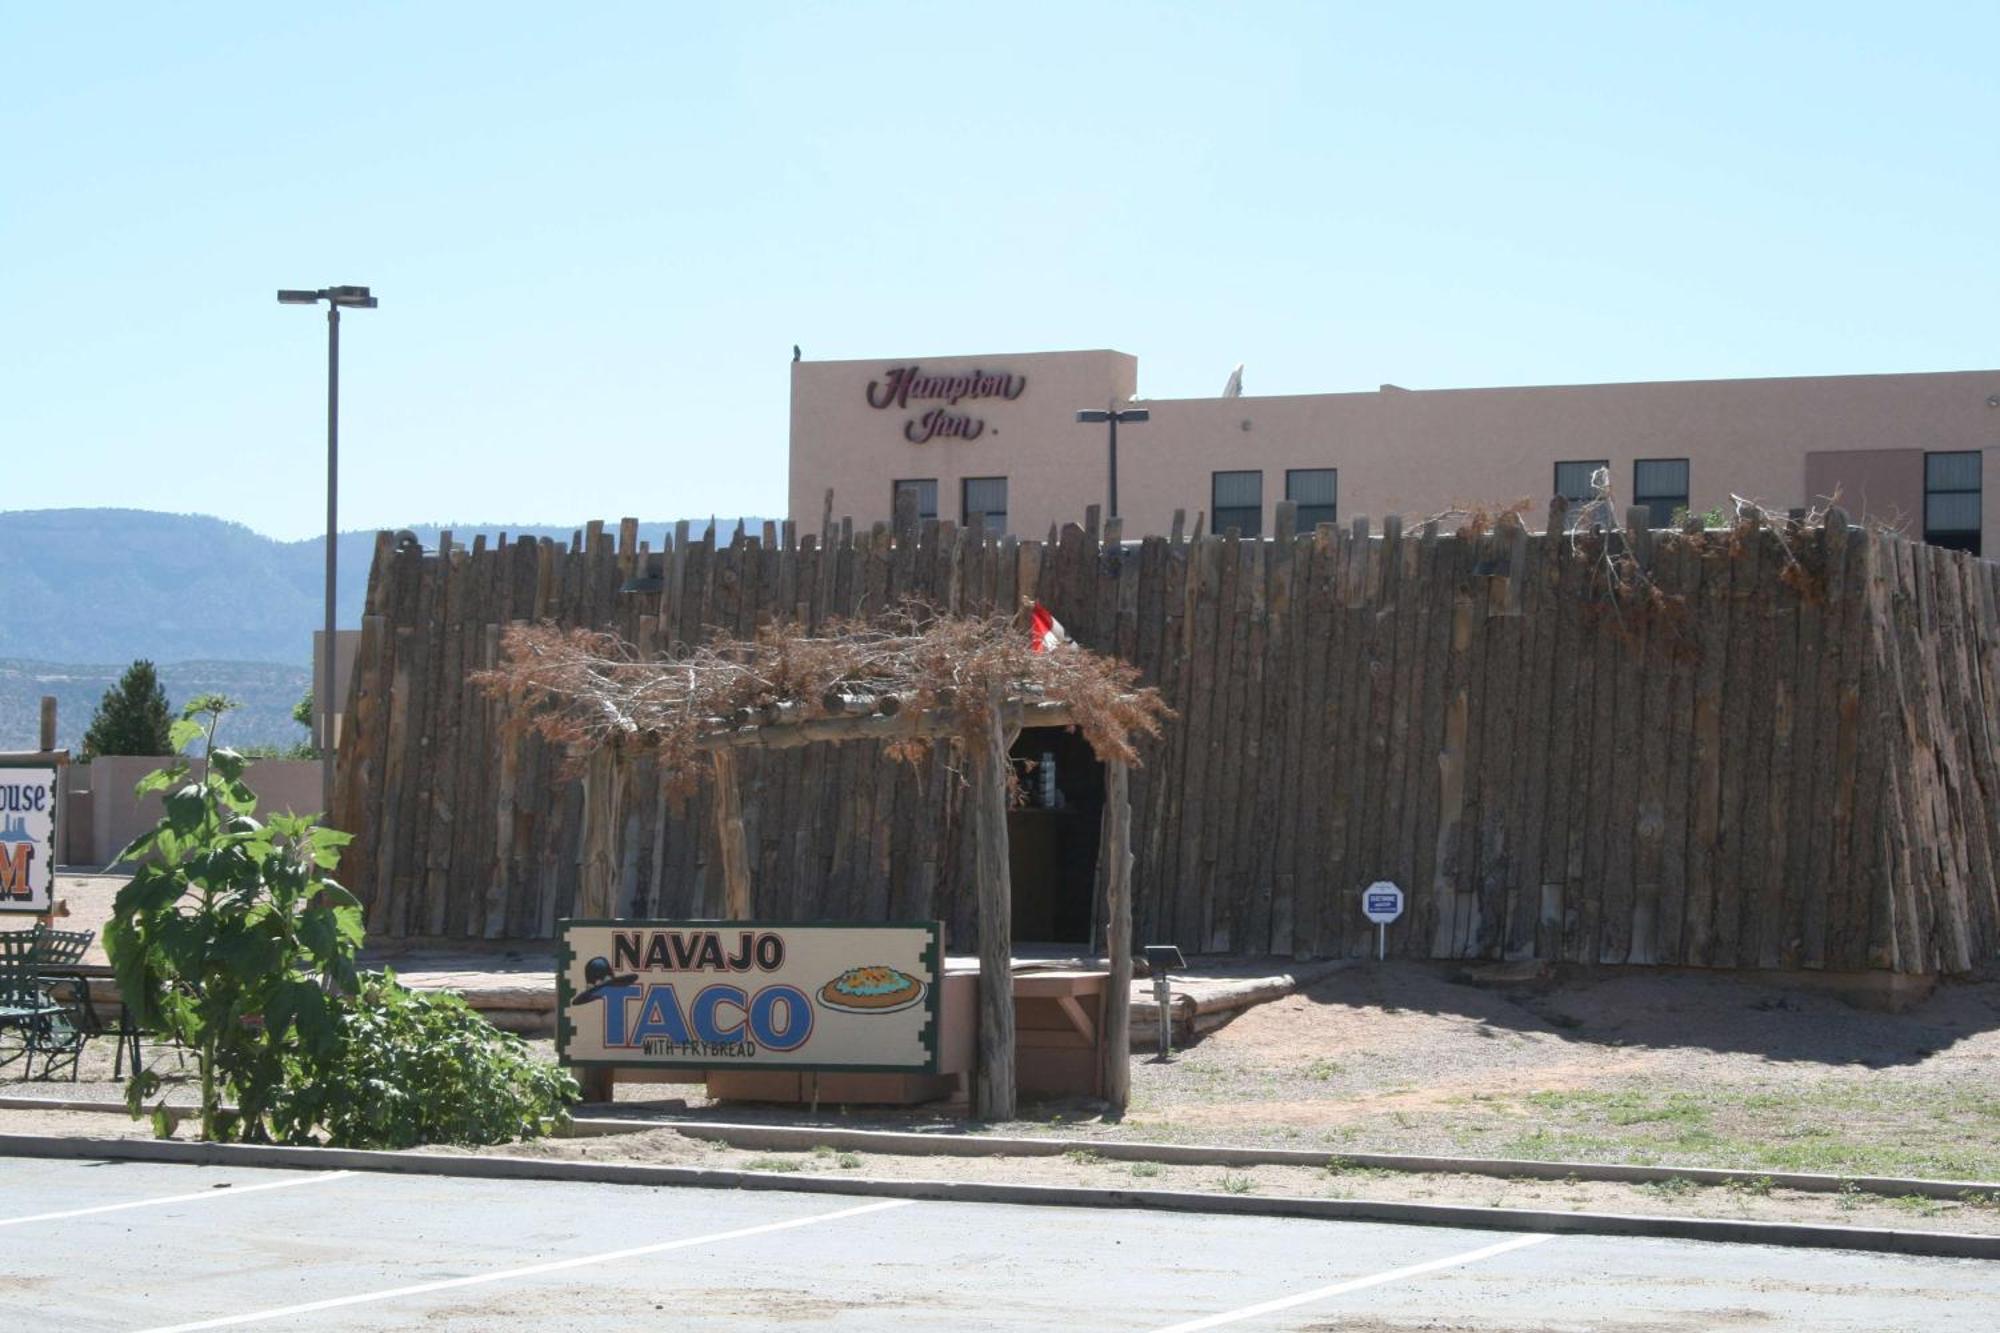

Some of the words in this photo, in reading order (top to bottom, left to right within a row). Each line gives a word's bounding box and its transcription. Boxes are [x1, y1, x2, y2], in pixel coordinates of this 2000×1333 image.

[866, 366, 1026, 408] Hampton
[904, 408, 984, 444] Inn
[611, 931, 786, 973] NAVAJO
[601, 983, 815, 1052] TACO
[643, 1039, 674, 1056] WITH
